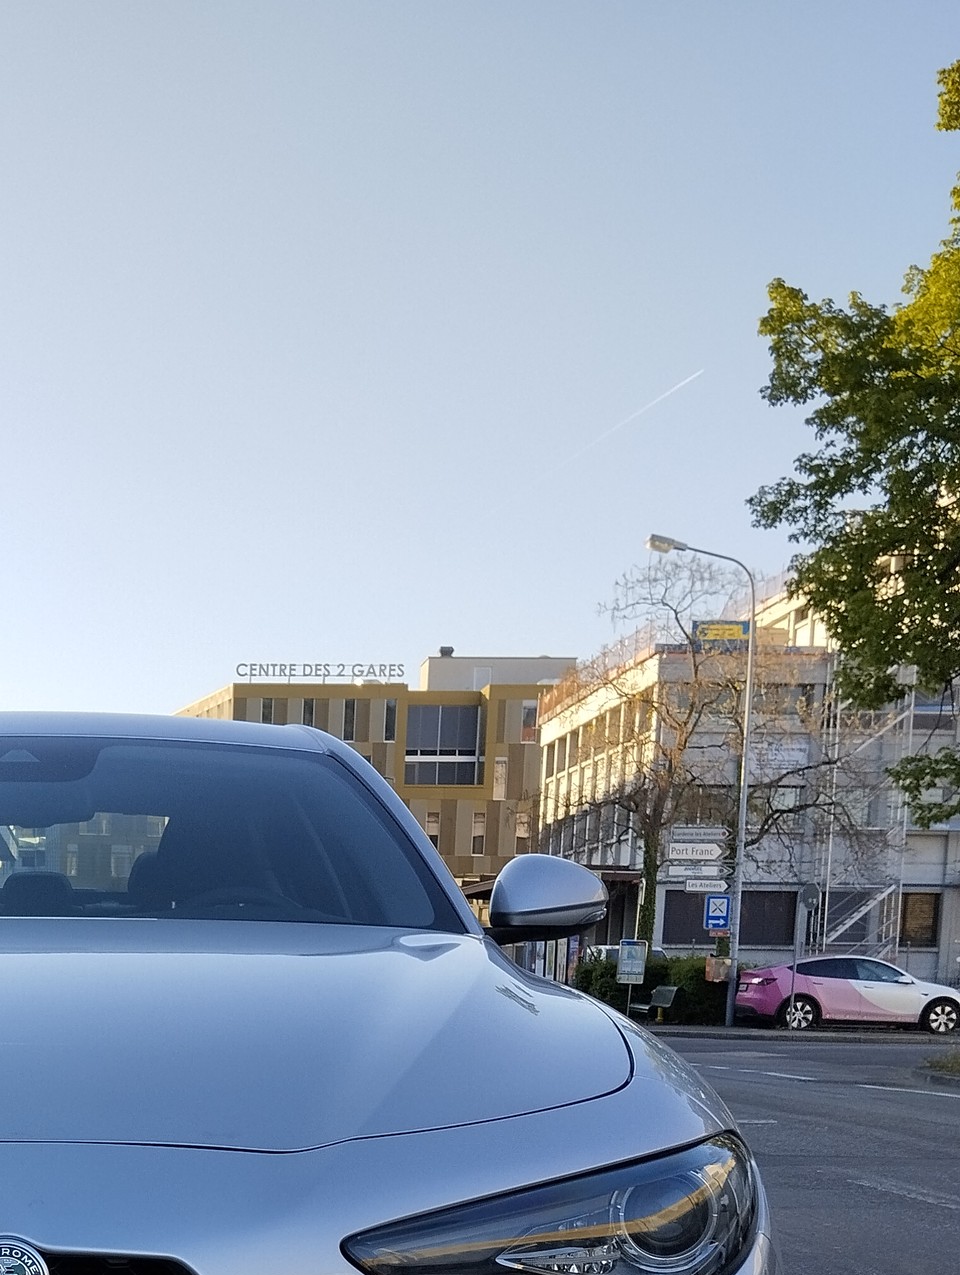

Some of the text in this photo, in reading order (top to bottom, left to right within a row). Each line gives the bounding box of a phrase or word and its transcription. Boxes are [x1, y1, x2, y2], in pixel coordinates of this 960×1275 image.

[236, 663, 405, 677] CENTRE DES 2 GARES
[670, 847, 714, 856] Port Franc
